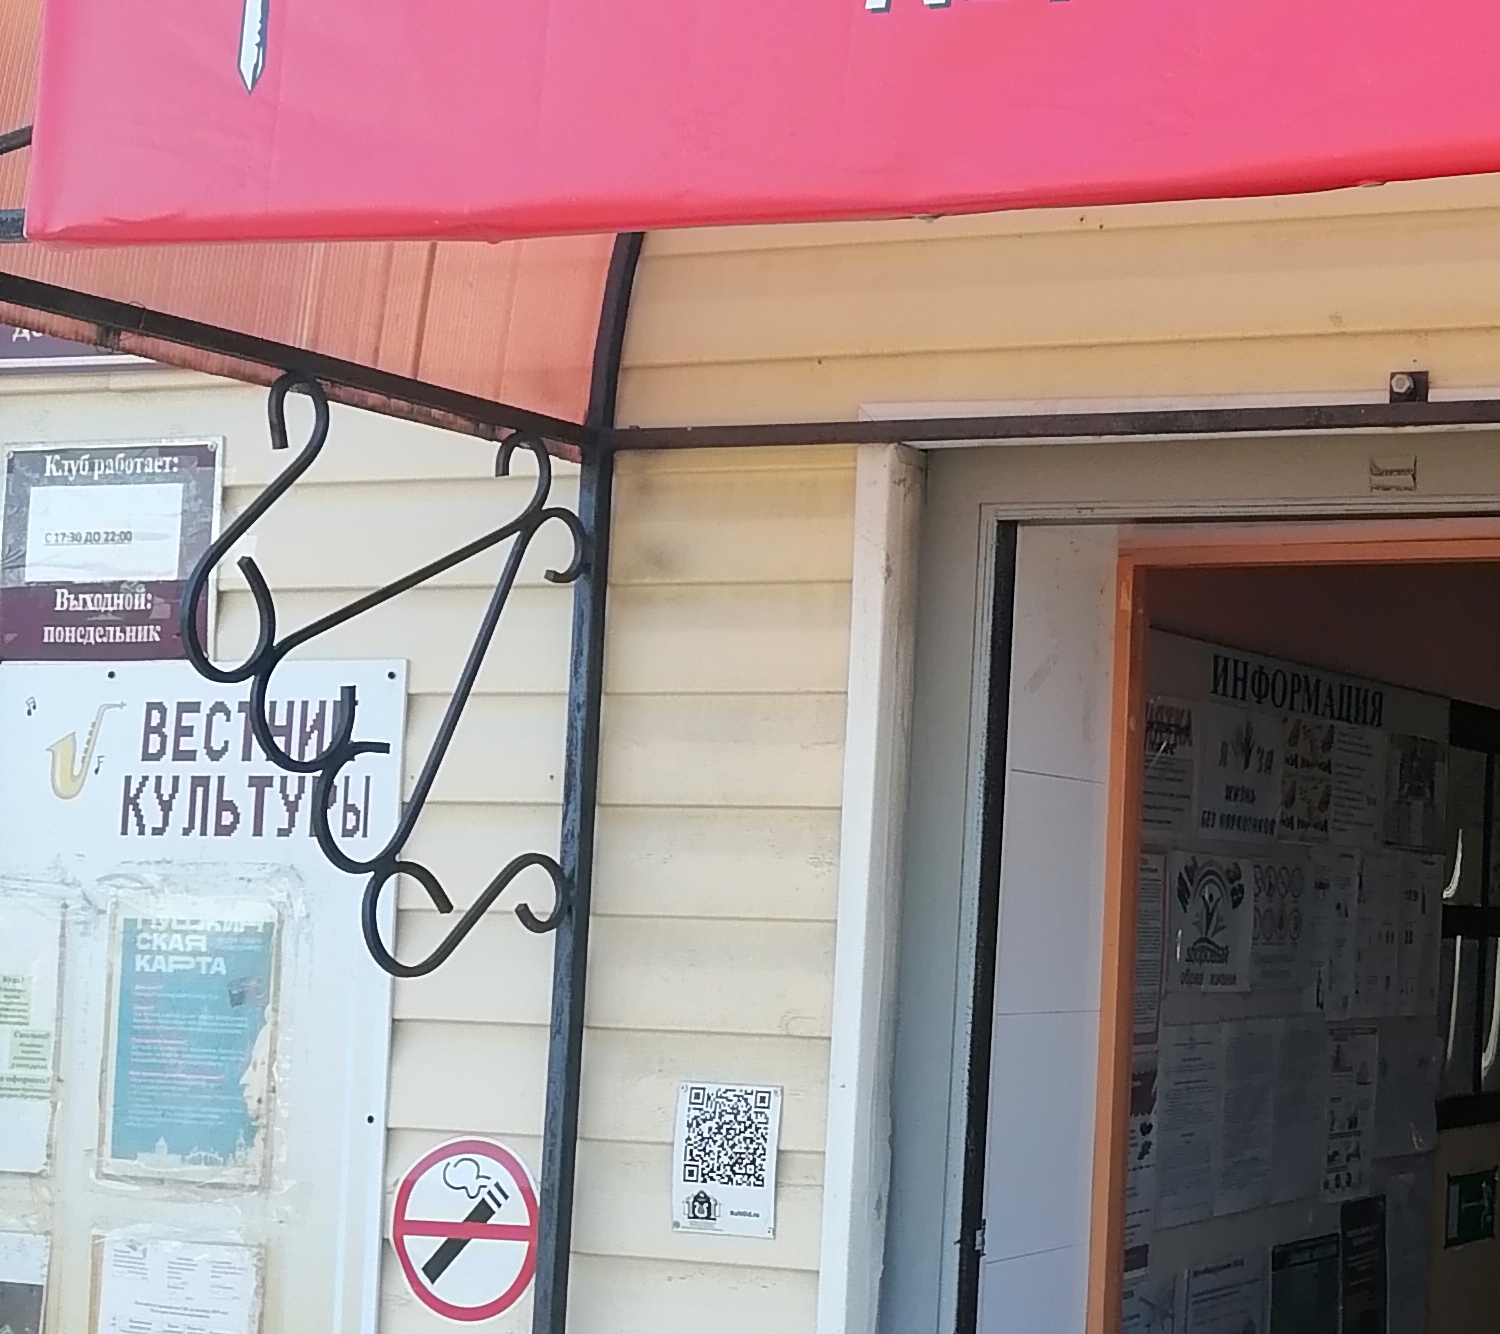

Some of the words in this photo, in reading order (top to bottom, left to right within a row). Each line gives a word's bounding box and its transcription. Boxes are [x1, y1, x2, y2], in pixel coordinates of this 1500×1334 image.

[44, 454, 91, 481] Клуб
[93, 453, 179, 480] работает:
[84, 531, 101, 545] ДО
[103, 530, 133, 543] 22:00
[54, 588, 153, 612] Выходной:
[43, 625, 161, 646] понедельник
[1210, 654, 1383, 727] ИНФОРМАЦИЯ
[136, 933, 207, 952] СКАЯ
[135, 954, 227, 975] КАРТА
